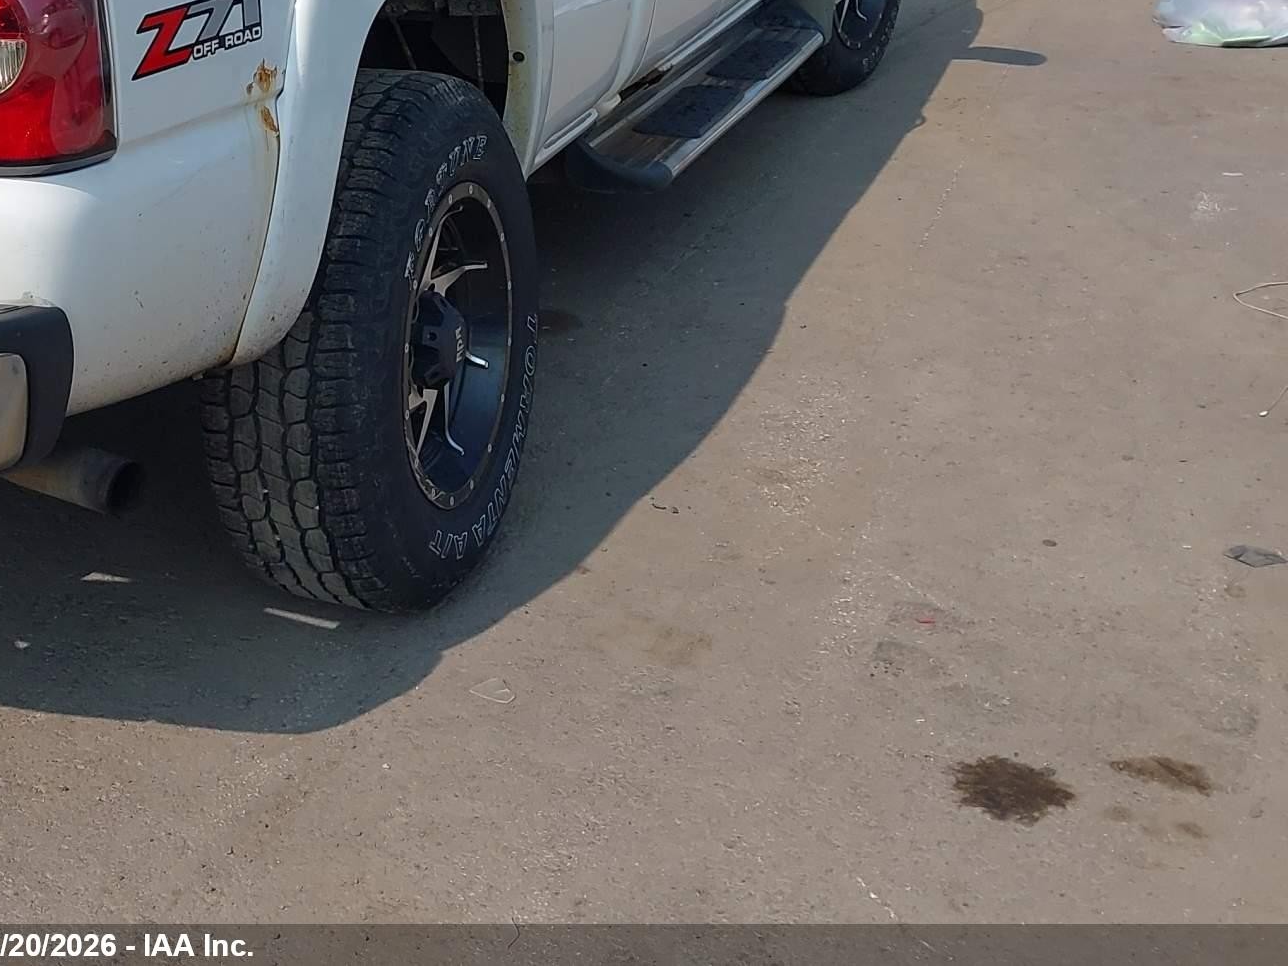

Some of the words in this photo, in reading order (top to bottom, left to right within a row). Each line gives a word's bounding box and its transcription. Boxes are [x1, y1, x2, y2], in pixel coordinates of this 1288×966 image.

[193, 39, 220, 59] OFF
[225, 25, 262, 49] ROAD
[428, 529, 468, 560] A/T
